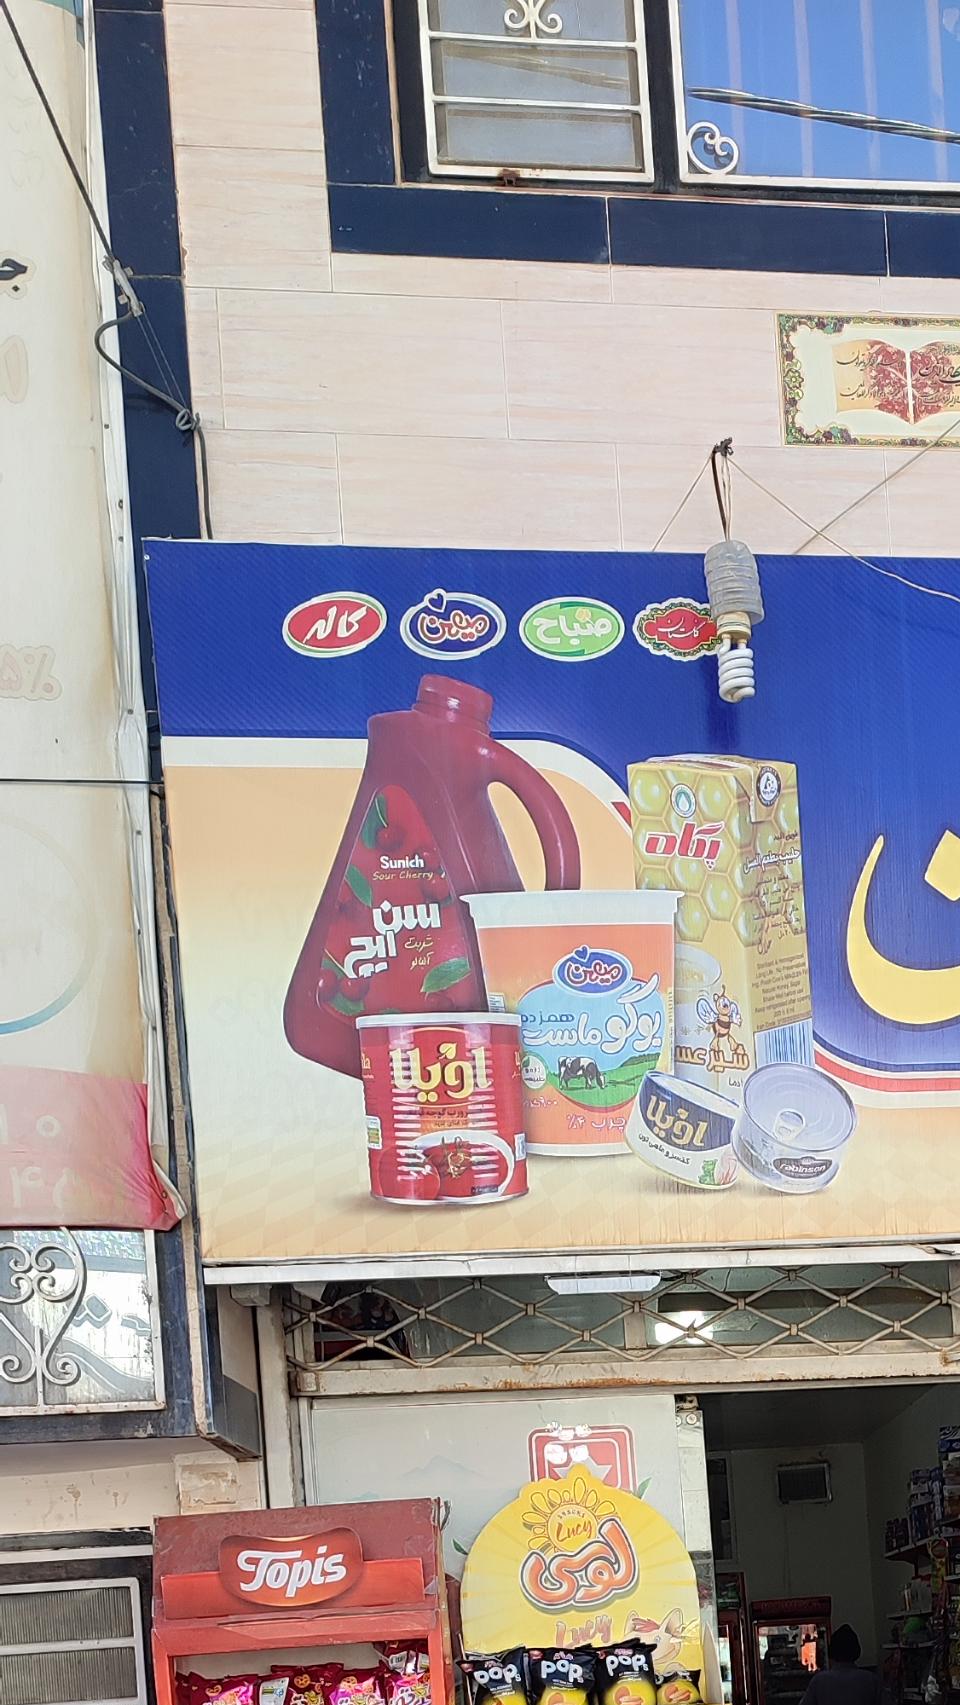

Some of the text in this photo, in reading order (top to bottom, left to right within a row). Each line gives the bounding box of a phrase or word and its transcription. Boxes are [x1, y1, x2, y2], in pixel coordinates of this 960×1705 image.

[302, 605, 368, 643] کاله
[418, 609, 490, 643] میهن
[645, 821, 725, 871] پگاه
[372, 870, 434, 881] Sour Cherry
[380, 854, 425, 869] Sunich
[566, 961, 622, 984] میهن
[521, 1012, 603, 1047] ماست
[675, 1044, 750, 1073] شیر عس
[592, 1117, 626, 1132] چرب
[556, 1520, 593, 1542] Lucy
[236, 1545, 347, 1598] Topis
